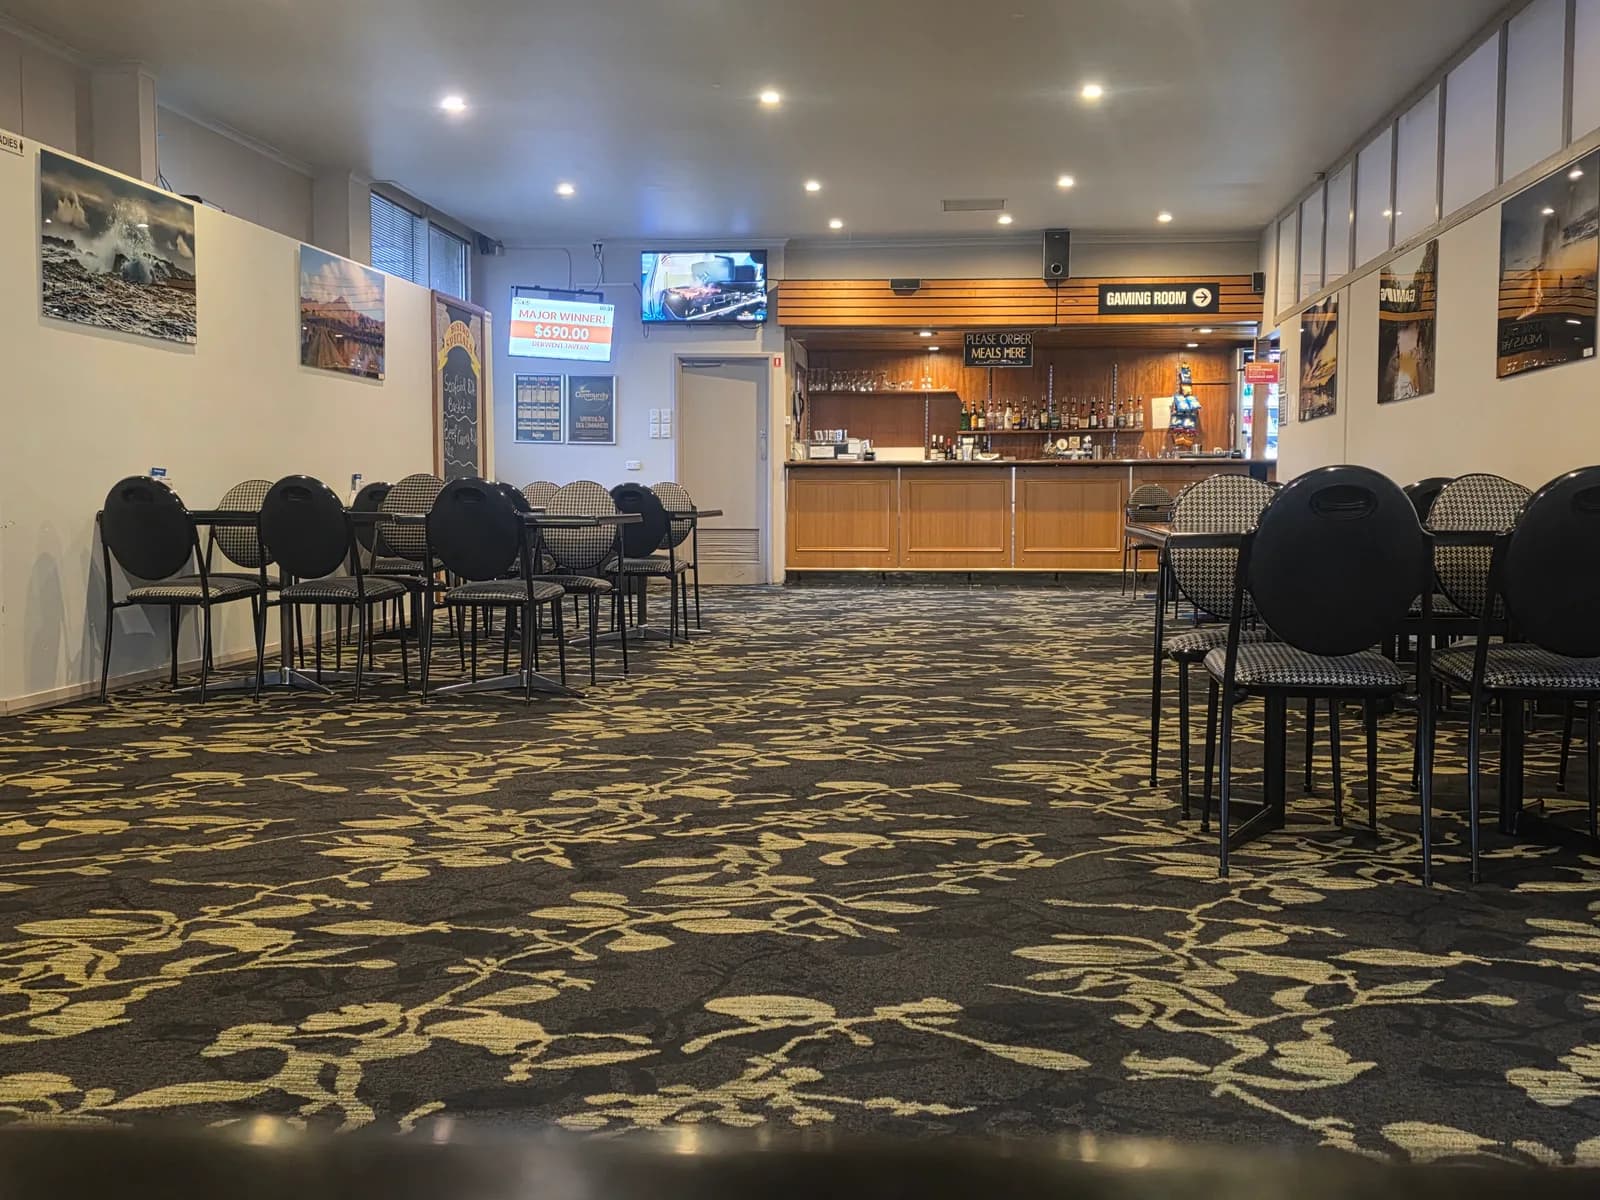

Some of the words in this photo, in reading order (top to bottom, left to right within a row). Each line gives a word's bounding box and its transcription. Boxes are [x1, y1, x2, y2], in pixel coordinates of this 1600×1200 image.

[1106, 291, 1151, 306] GAMING
[1153, 291, 1187, 305] ROOM
[519, 309, 557, 320] MAJOR
[560, 311, 606, 324] WINNER!
[534, 323, 590, 341] $690.00
[966, 333, 997, 345] PLEASE
[999, 333, 1032, 345] ORDER
[971, 346, 1002, 359] MEALS
[1004, 346, 1027, 359] HERE
